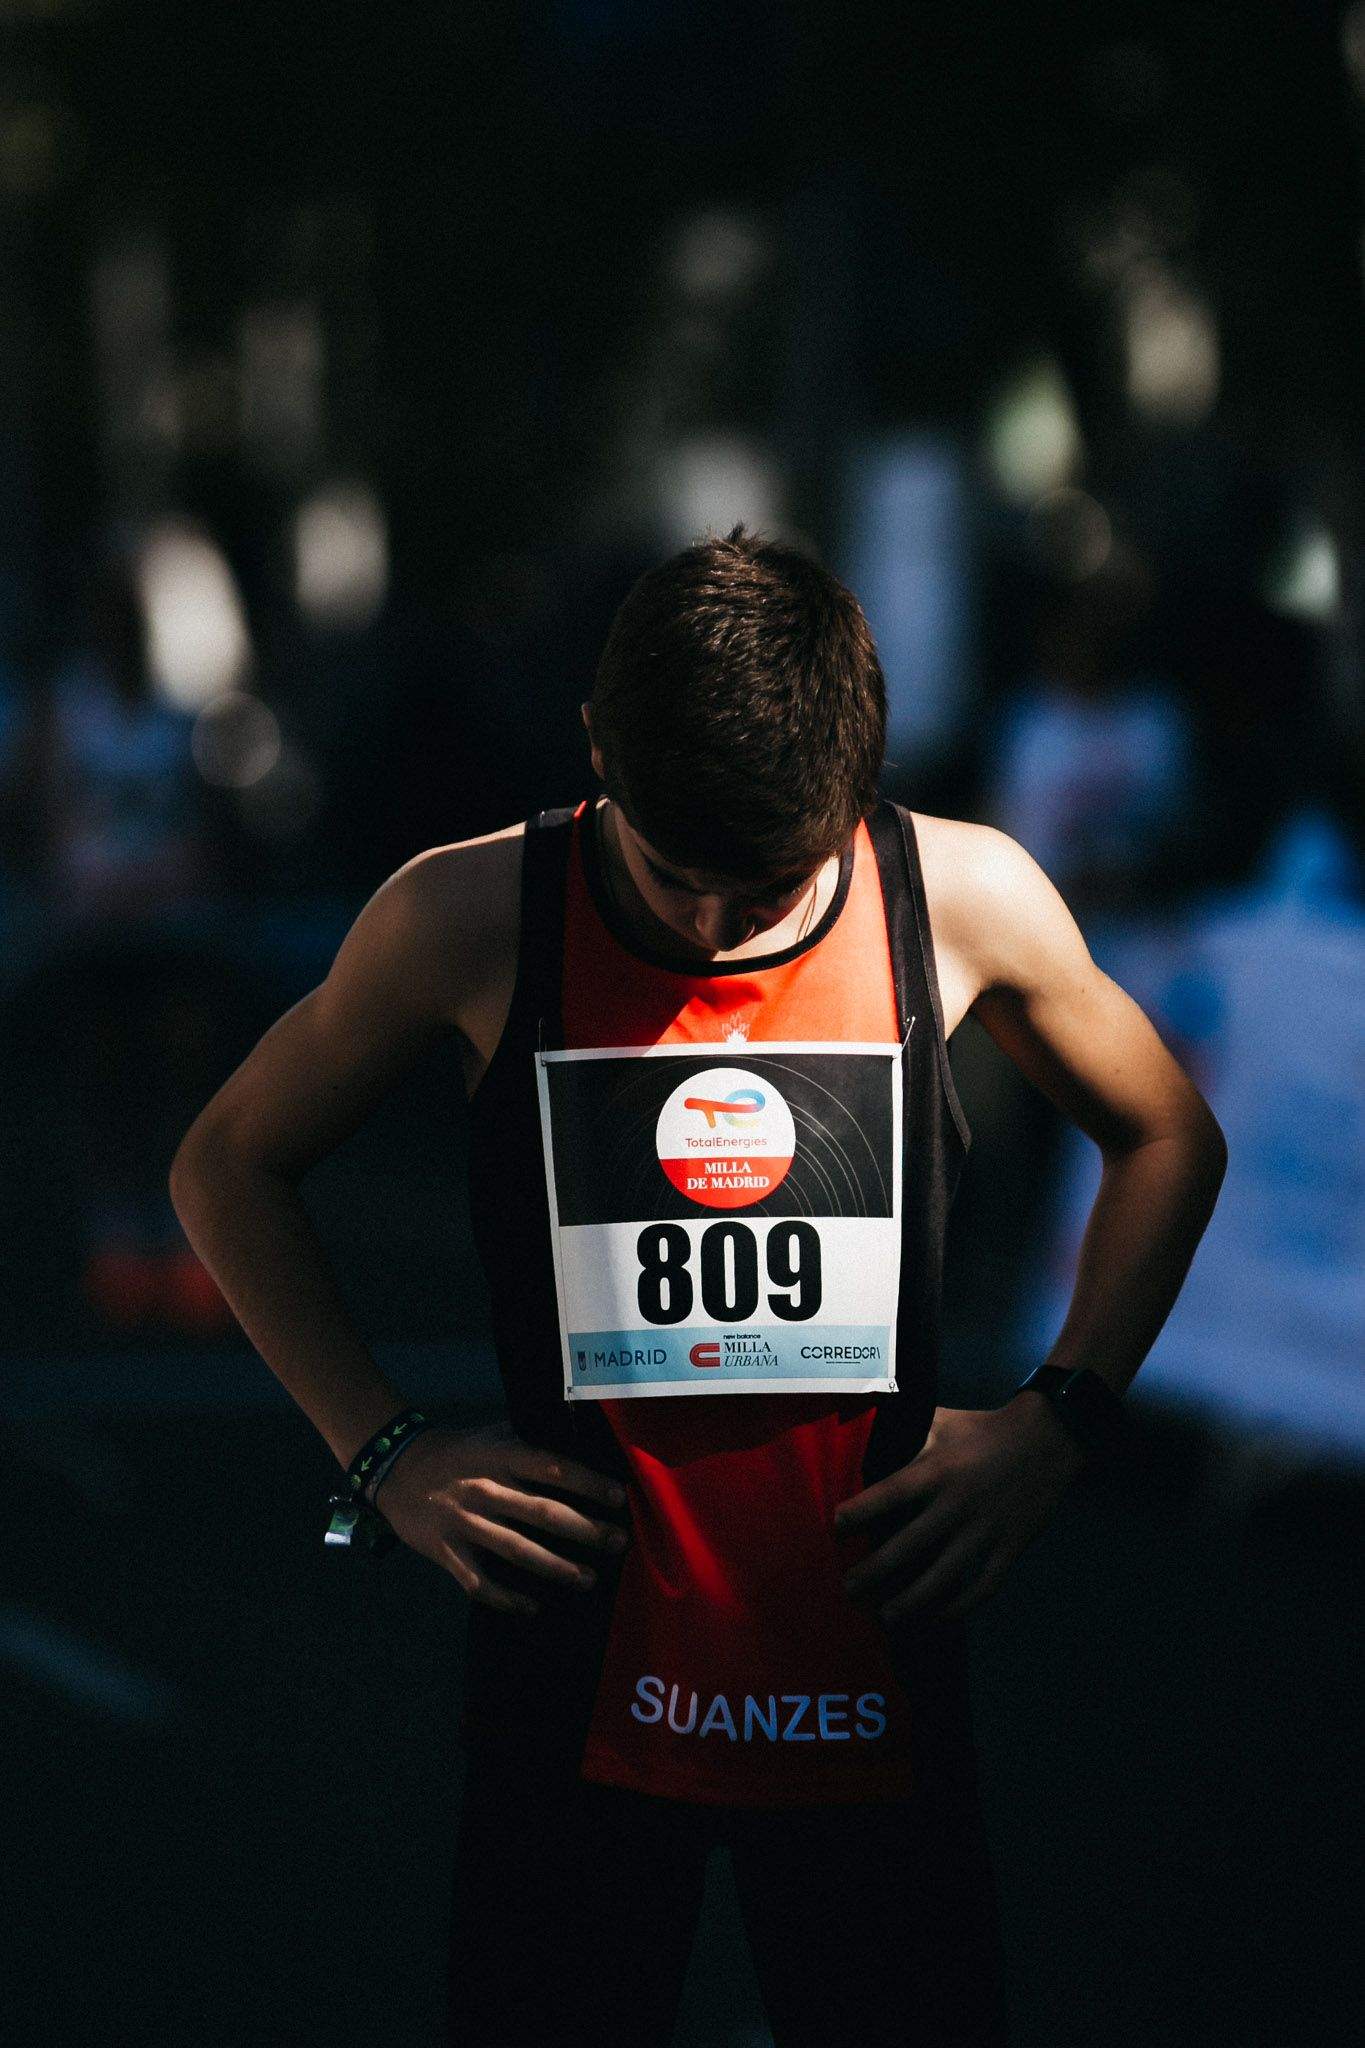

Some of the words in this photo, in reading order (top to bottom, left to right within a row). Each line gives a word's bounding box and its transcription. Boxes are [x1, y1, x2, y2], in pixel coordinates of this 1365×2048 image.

[685, 1137, 768, 1149] TotalEnergies
[704, 1161, 753, 1175] MILLA
[686, 1177, 708, 1190] DE
[711, 1176, 770, 1189] MADRID
[636, 1220, 823, 1326] 809
[723, 1341, 773, 1353] MILLA
[594, 1349, 668, 1368] MADRID
[724, 1355, 779, 1368] URBANA
[630, 1675, 887, 1742] SUANZES
